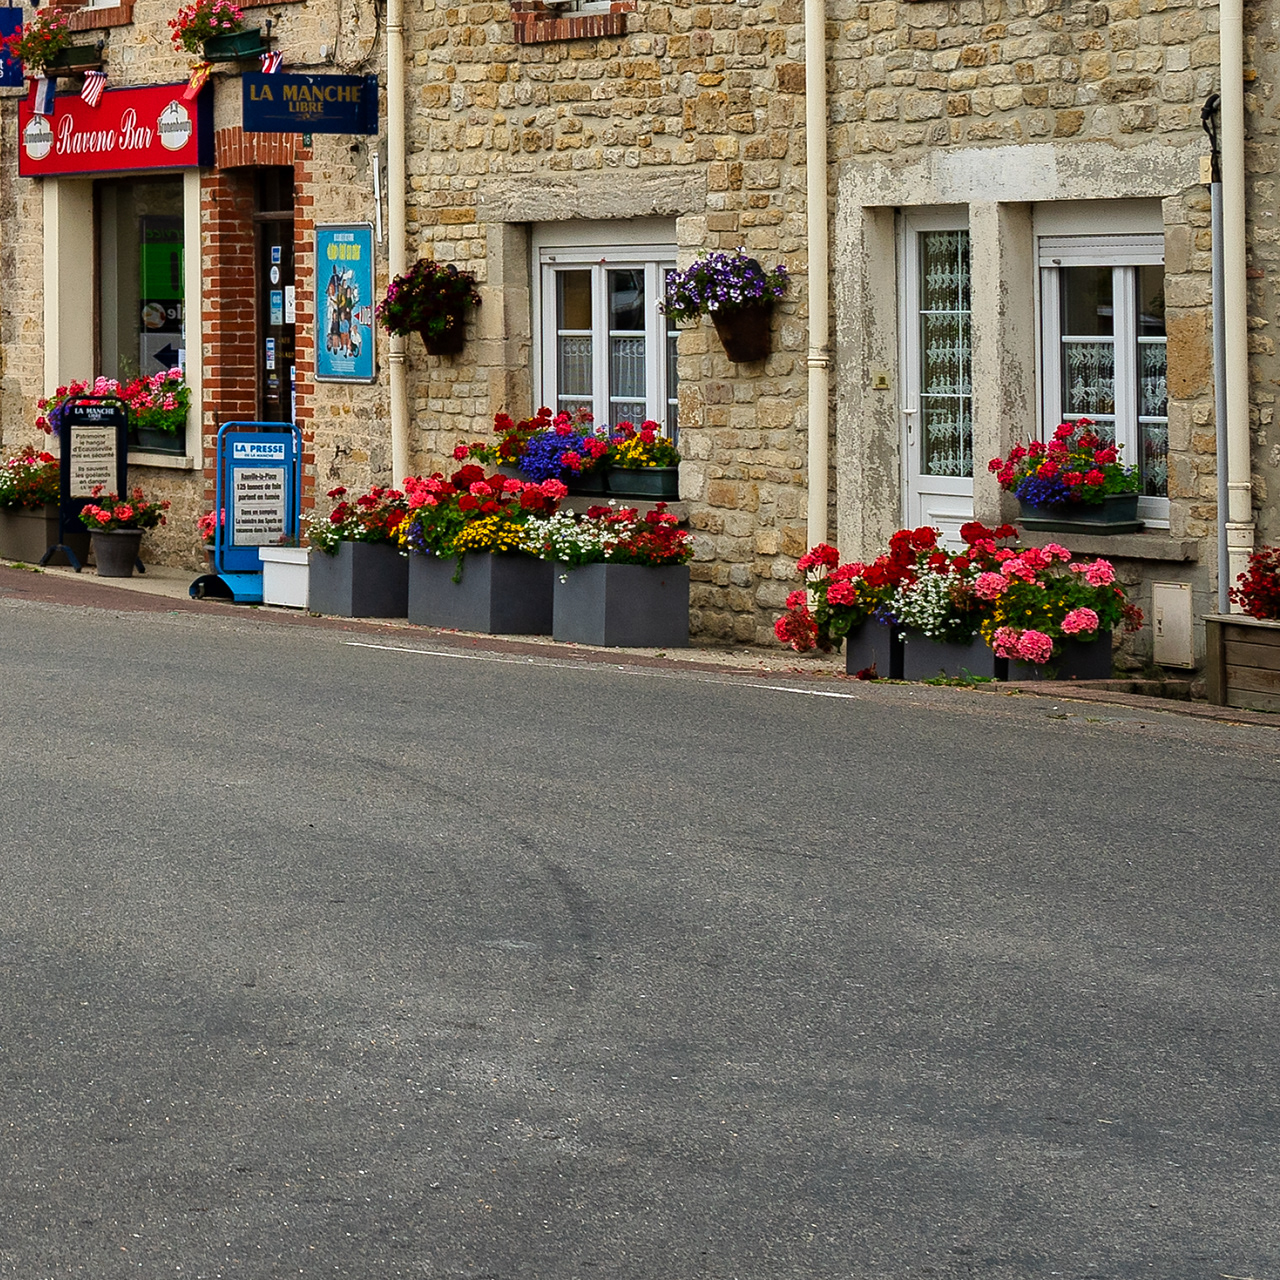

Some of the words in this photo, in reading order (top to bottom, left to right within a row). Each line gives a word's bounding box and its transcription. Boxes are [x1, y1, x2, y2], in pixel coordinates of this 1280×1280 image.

[250, 84, 274, 101] LA
[282, 84, 361, 103] MANCHE
[288, 101, 324, 113] LIBRE
[56, 113, 118, 155] Raveno
[119, 108, 155, 150] Bar
[235, 445, 246, 453] LA
[250, 445, 283, 453] PRESSE
